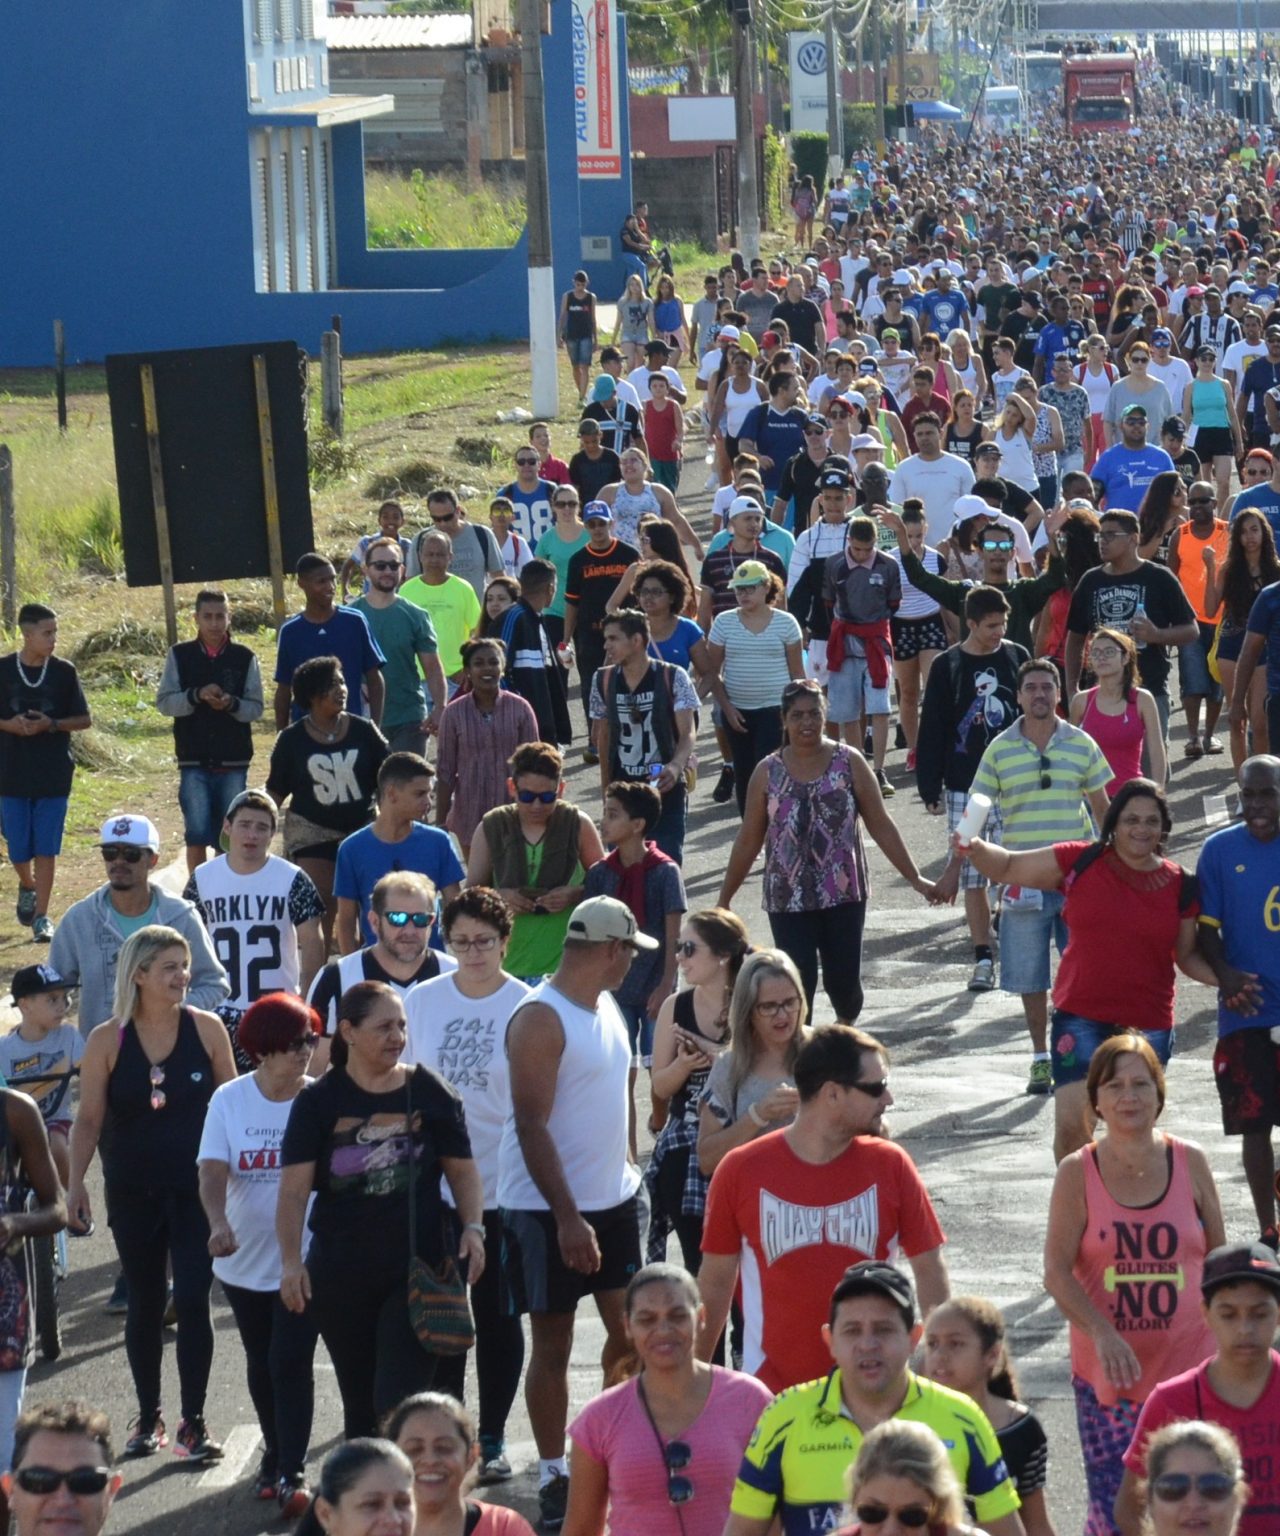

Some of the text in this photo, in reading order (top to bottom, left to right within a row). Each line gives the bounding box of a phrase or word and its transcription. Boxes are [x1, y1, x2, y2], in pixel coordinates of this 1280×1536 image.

[307, 748, 362, 806] SK
[213, 925, 282, 1003] 92
[1112, 1221, 1178, 1260] NO
[1116, 1262, 1177, 1275] GLUTES
[1113, 1280, 1178, 1318] NO
[1115, 1318, 1172, 1331] GLORY
[799, 1440, 853, 1453] GARMIN
